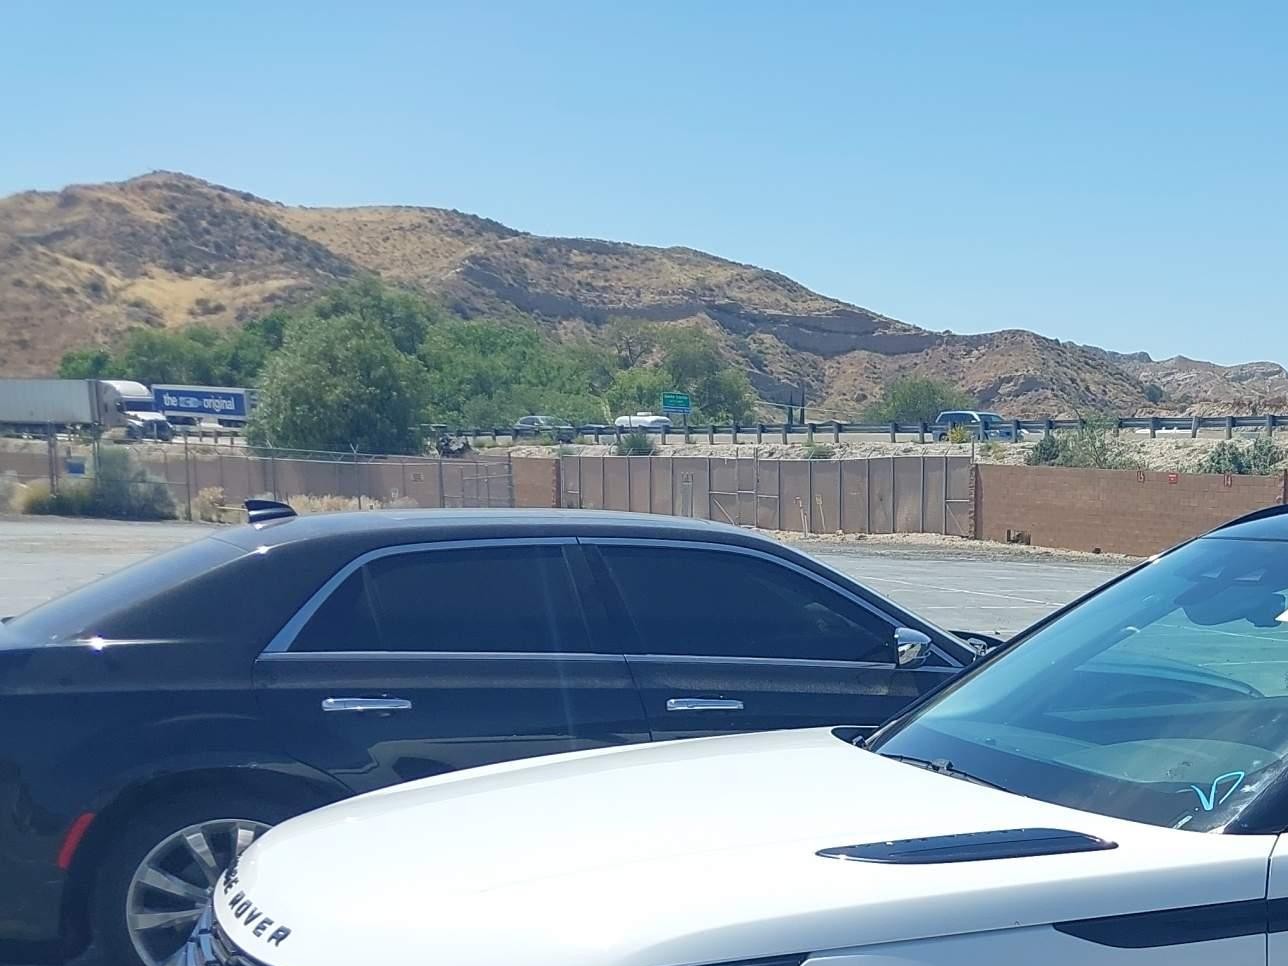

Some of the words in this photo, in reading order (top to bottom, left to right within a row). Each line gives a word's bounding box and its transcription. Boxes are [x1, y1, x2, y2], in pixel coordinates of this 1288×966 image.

[163, 392, 178, 407] the
[203, 395, 236, 412] original
[228, 890, 292, 947] ROVER
